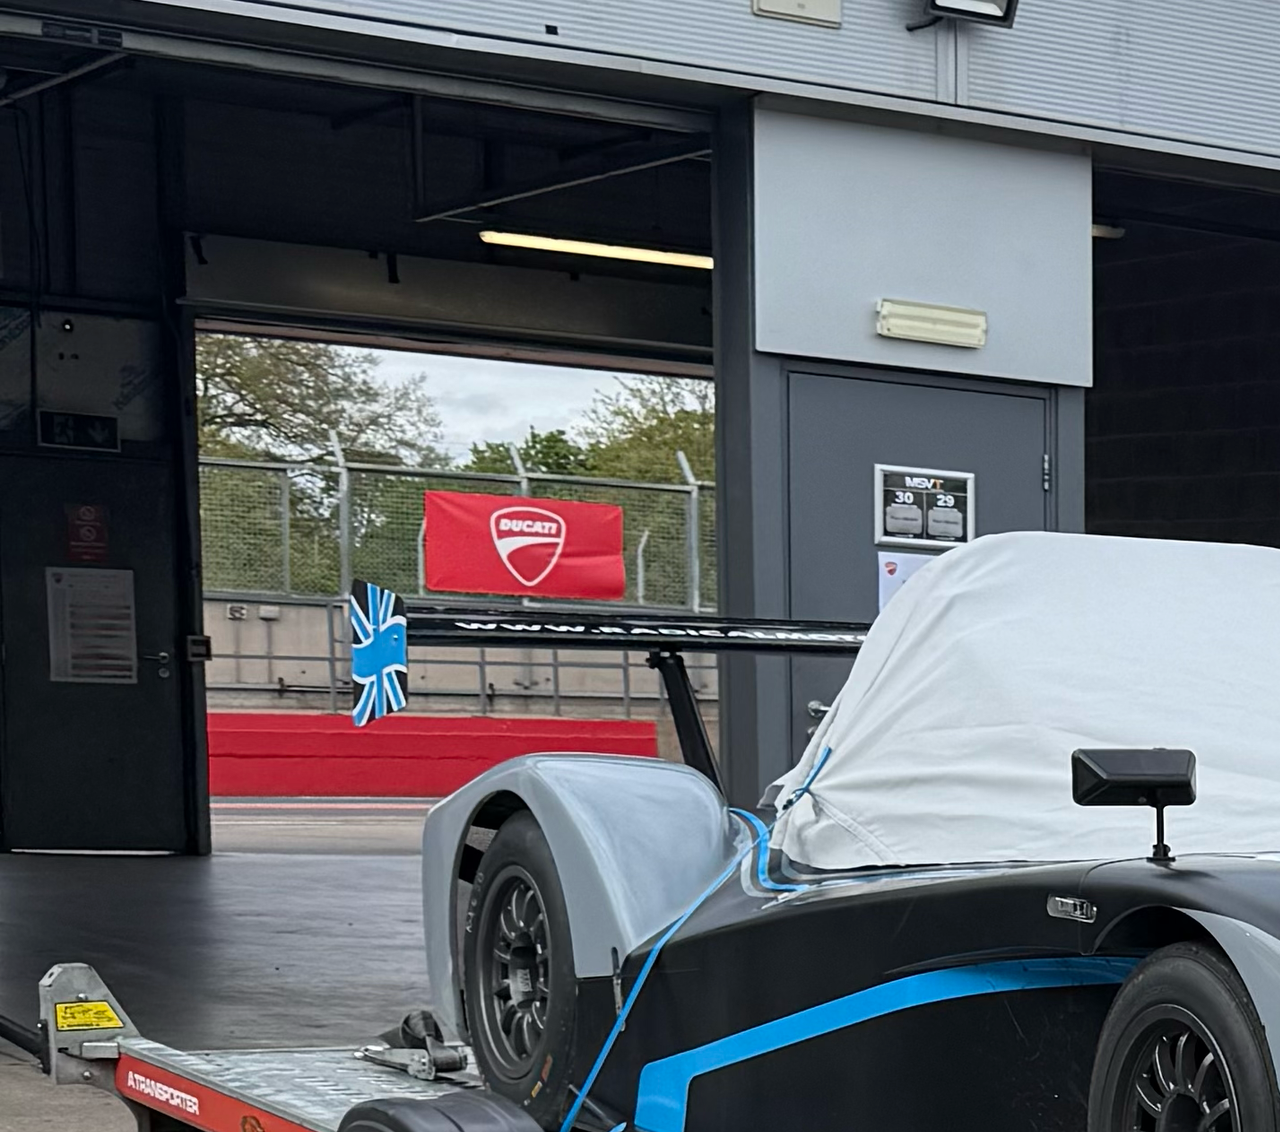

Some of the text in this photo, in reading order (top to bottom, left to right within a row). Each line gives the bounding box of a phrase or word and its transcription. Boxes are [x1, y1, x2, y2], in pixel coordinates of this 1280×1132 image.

[894, 491, 914, 504] 30
[936, 494, 955, 508] 29
[498, 518, 558, 535] DUCATI
[454, 622, 869, 642] WWW.RADICALMOT
